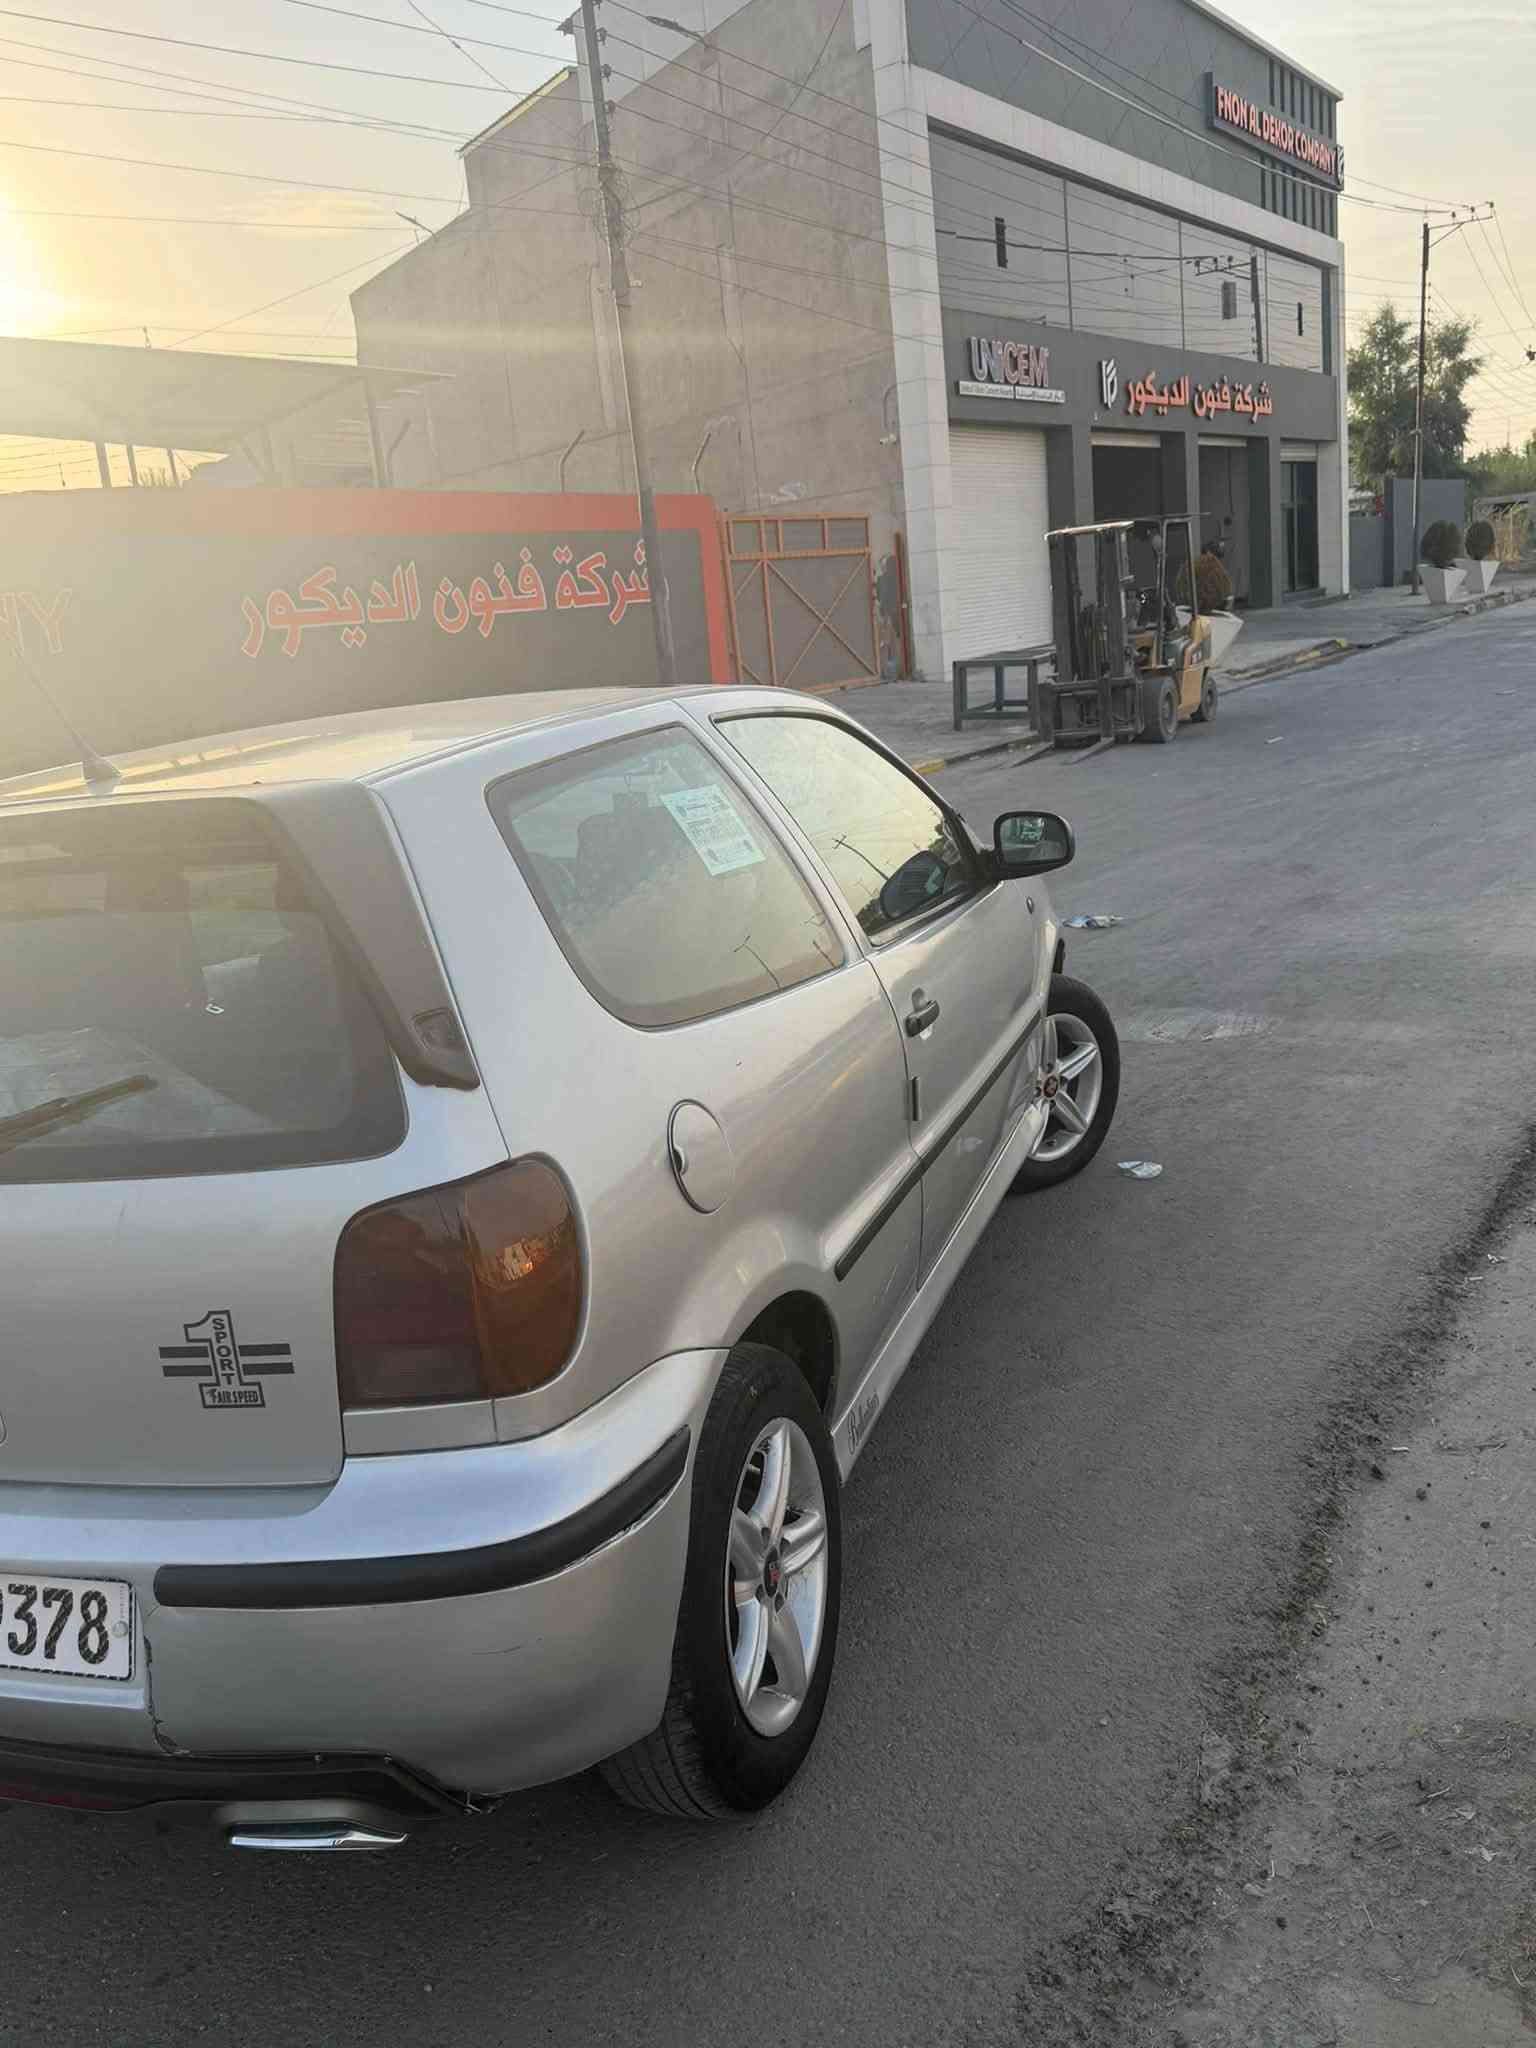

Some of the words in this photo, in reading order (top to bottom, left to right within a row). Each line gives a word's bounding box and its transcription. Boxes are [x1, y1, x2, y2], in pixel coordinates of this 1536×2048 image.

[1249, 104, 1261, 137] AL
[1262, 111, 1294, 155] DEKOR
[1295, 130, 1336, 175] COMPANY
[970, 335, 1049, 387] UNICEM
[1127, 371, 1190, 415] الديكور
[1194, 375, 1231, 420] فنون
[1233, 380, 1272, 423] شركة
[240, 560, 421, 658] الديكور
[432, 547, 548, 637] فنون
[212, 1317, 235, 1386] SPORT
[233, 1390, 259, 1404] SPEED
[0, 1583, 109, 1665] 378
